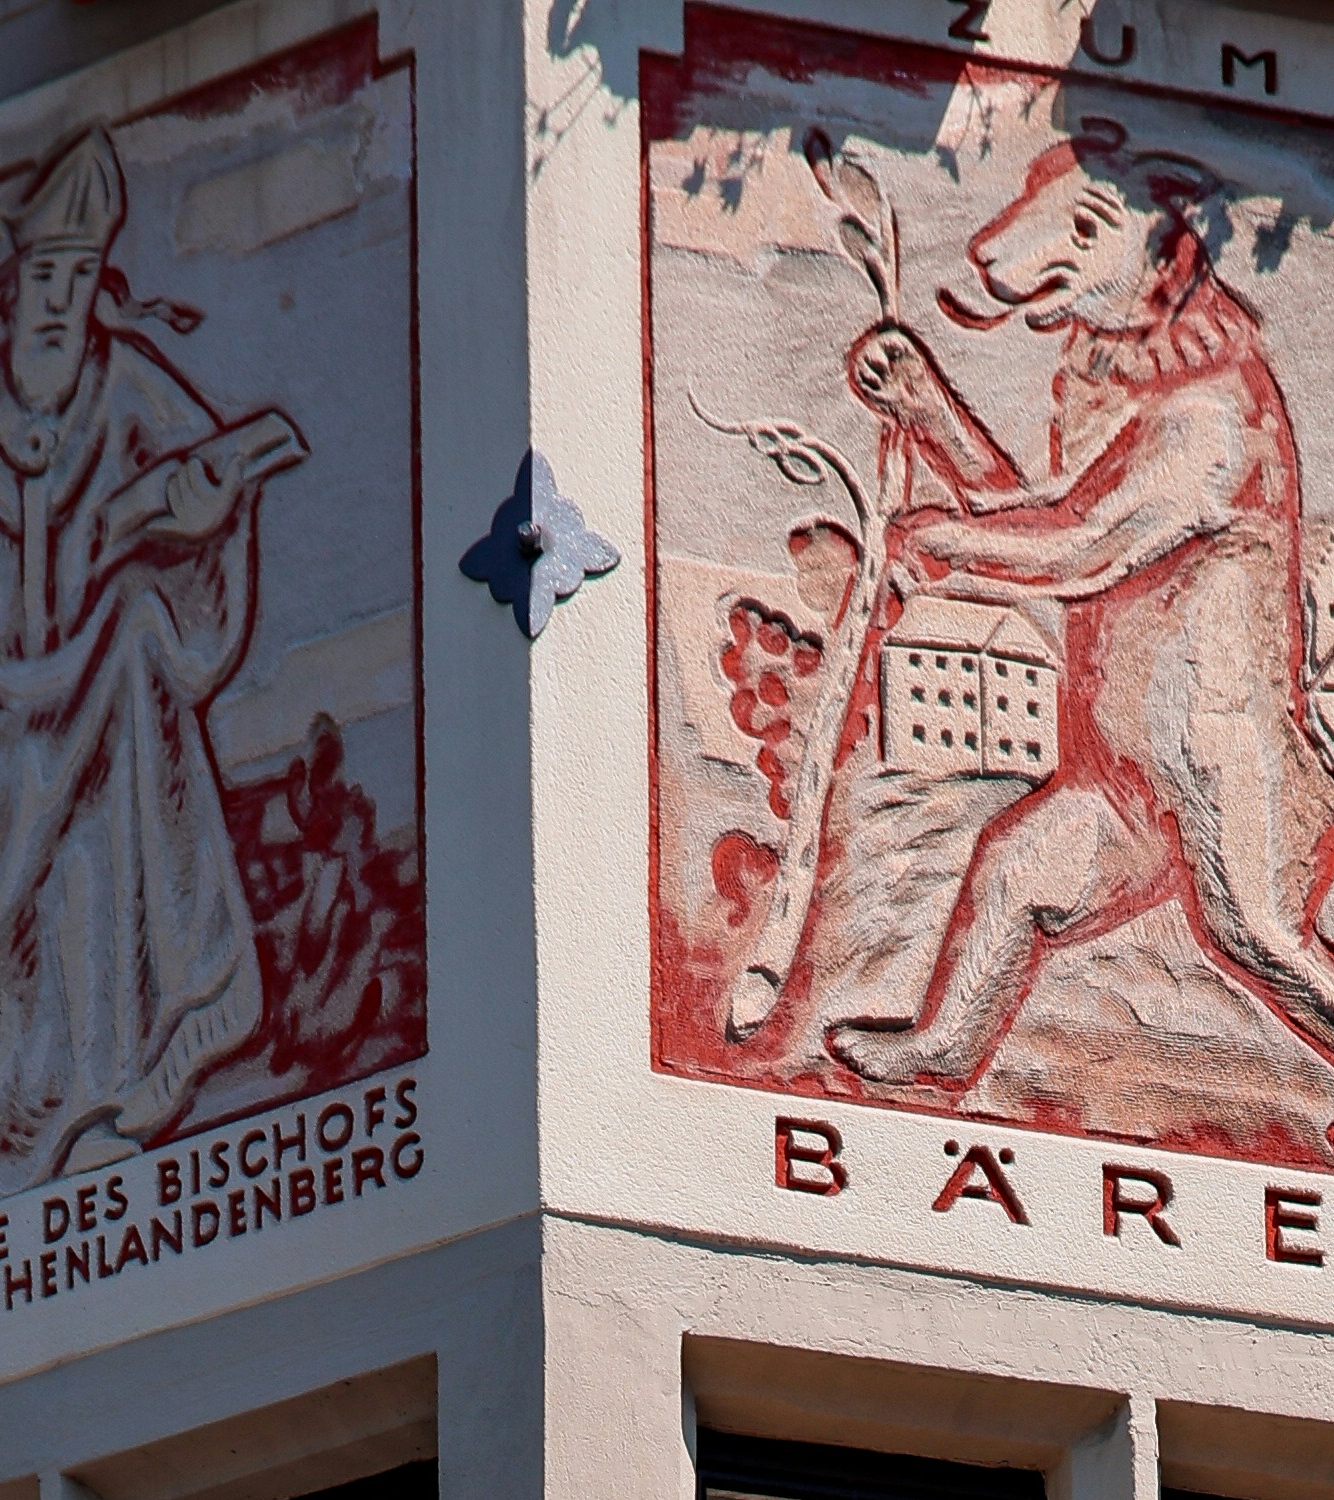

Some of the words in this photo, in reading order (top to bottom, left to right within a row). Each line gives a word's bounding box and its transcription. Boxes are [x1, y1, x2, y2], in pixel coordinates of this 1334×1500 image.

[945, 0, 1281, 96] ZUM
[43, 1172, 129, 1244] DES
[157, 1078, 421, 1199] BISCHOFS
